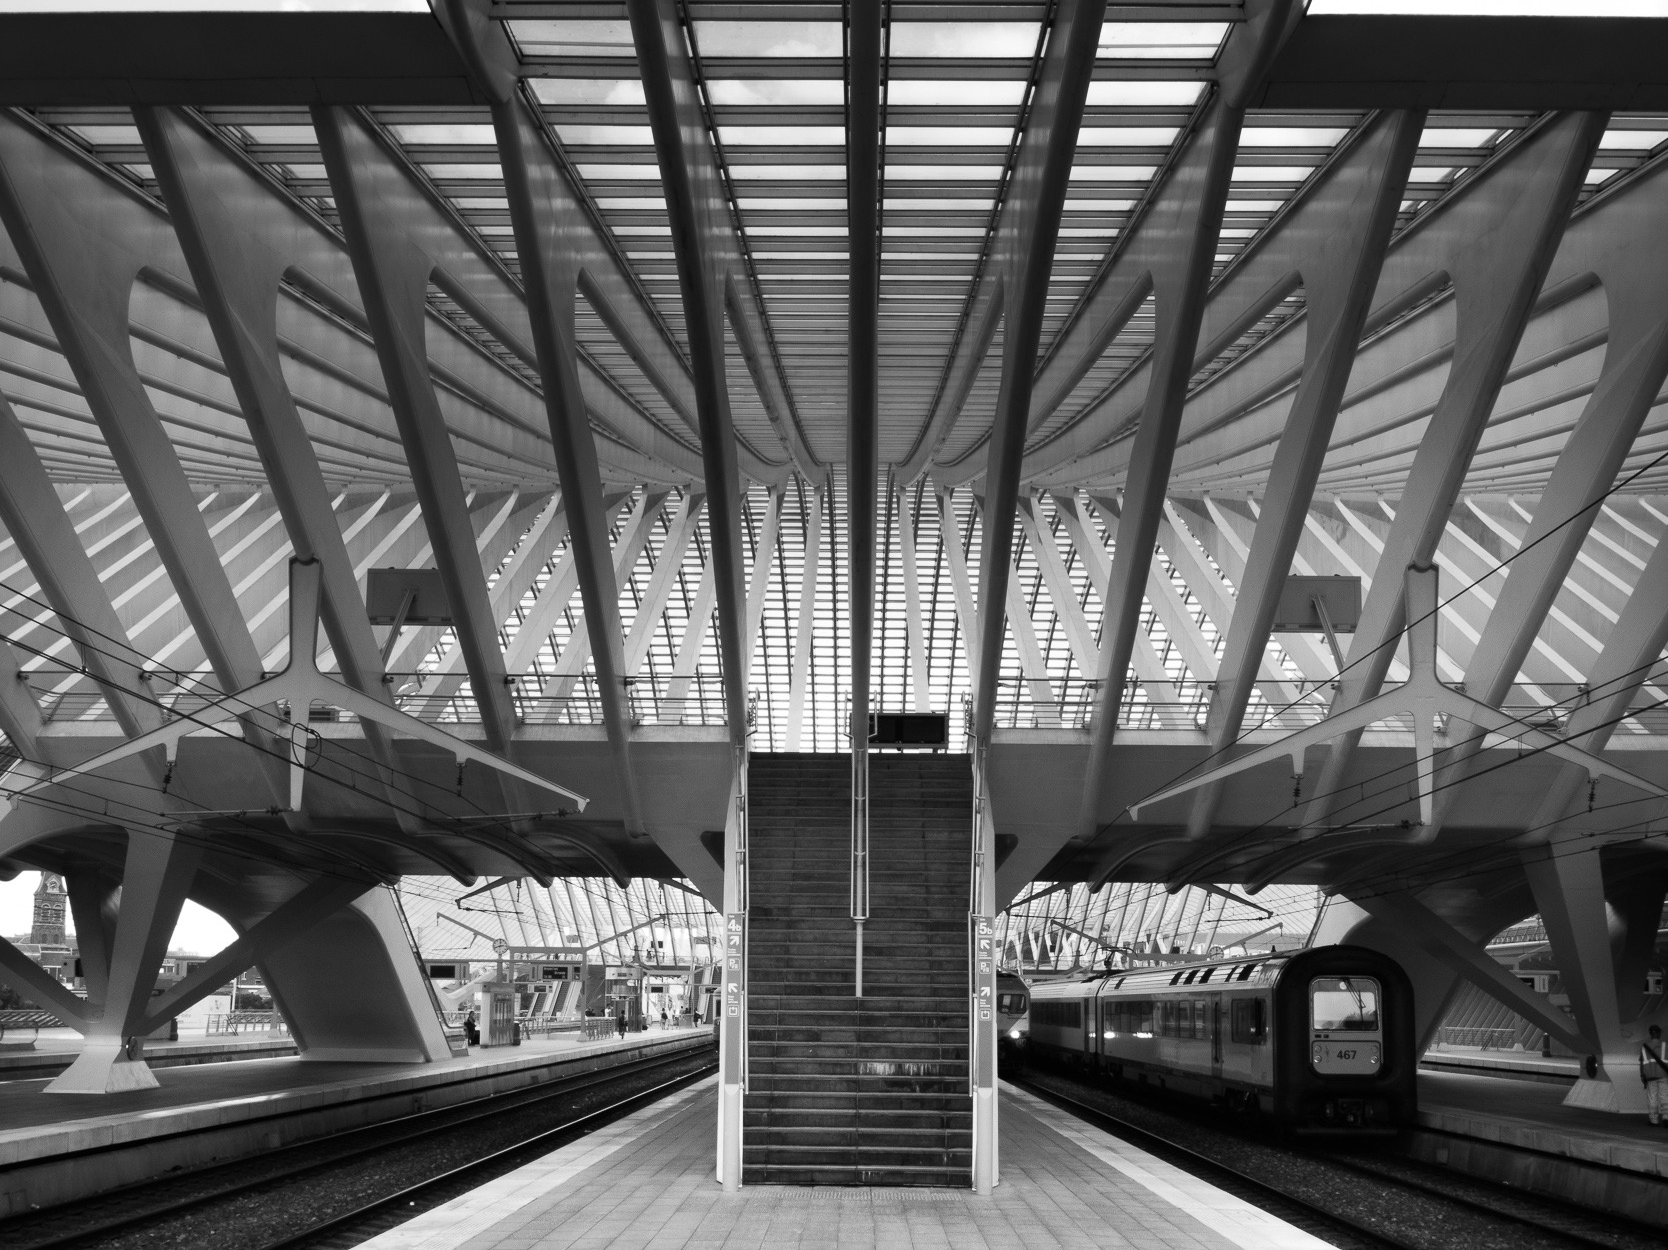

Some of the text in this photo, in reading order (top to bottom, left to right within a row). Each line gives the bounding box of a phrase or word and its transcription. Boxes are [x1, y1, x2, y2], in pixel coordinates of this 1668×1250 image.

[728, 919, 742, 931] 4b
[979, 922, 993, 935] 5b
[1337, 1050, 1357, 1060] 467
